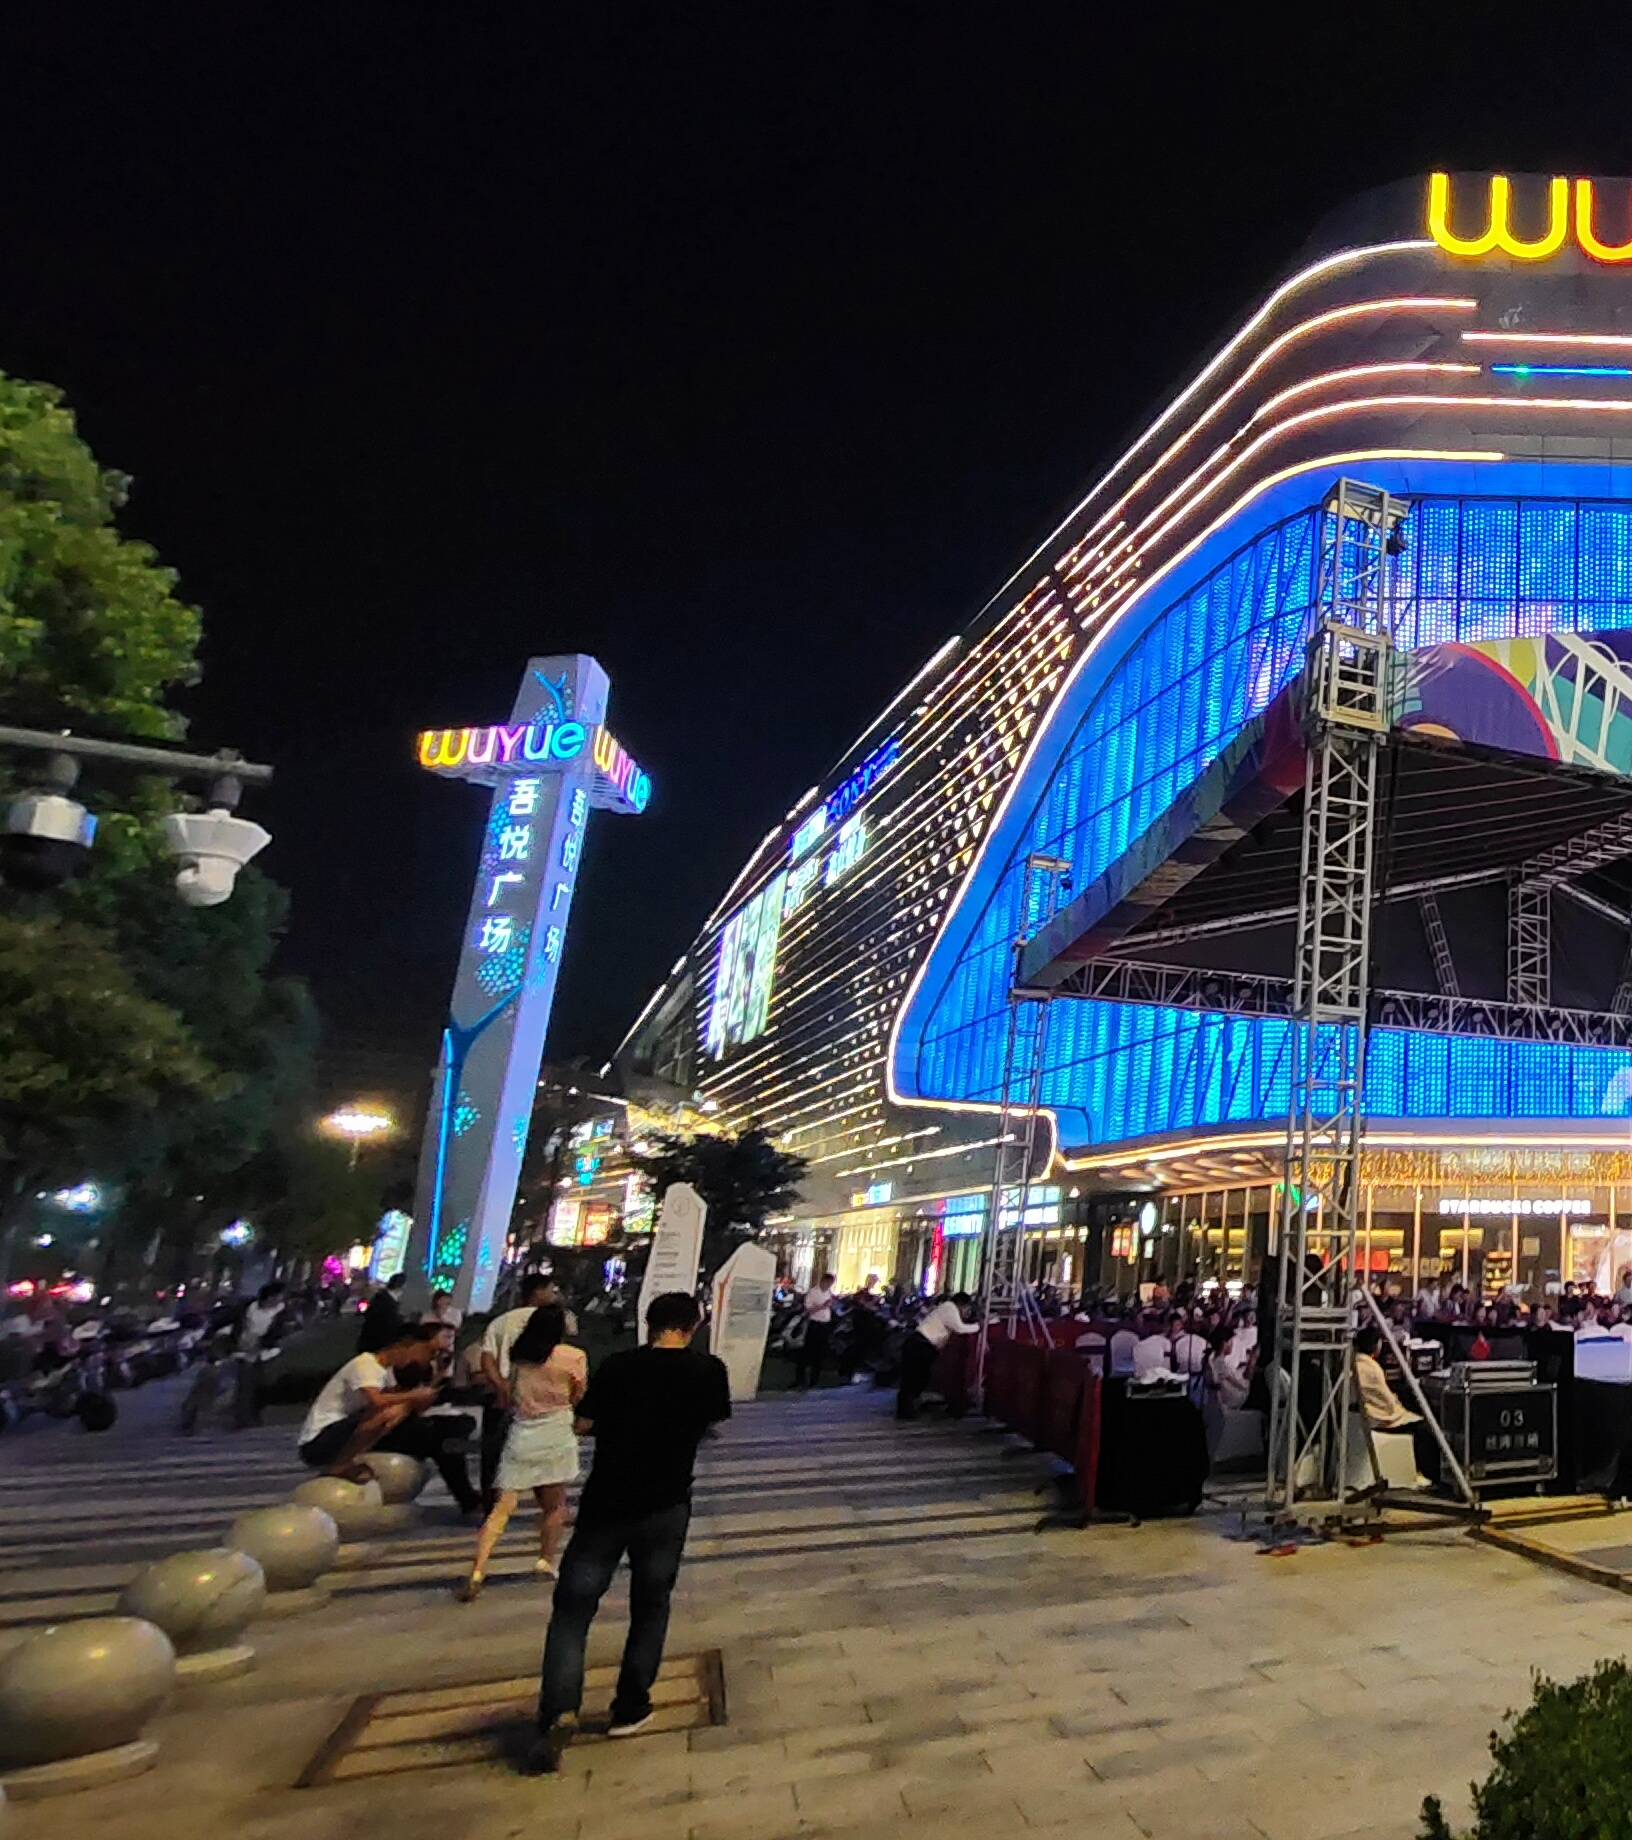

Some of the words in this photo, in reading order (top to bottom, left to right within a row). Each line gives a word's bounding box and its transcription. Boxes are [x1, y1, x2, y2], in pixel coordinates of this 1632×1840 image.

[480, 775, 541, 954] 吾悦广场
[1500, 1410, 1524, 1428] 03
